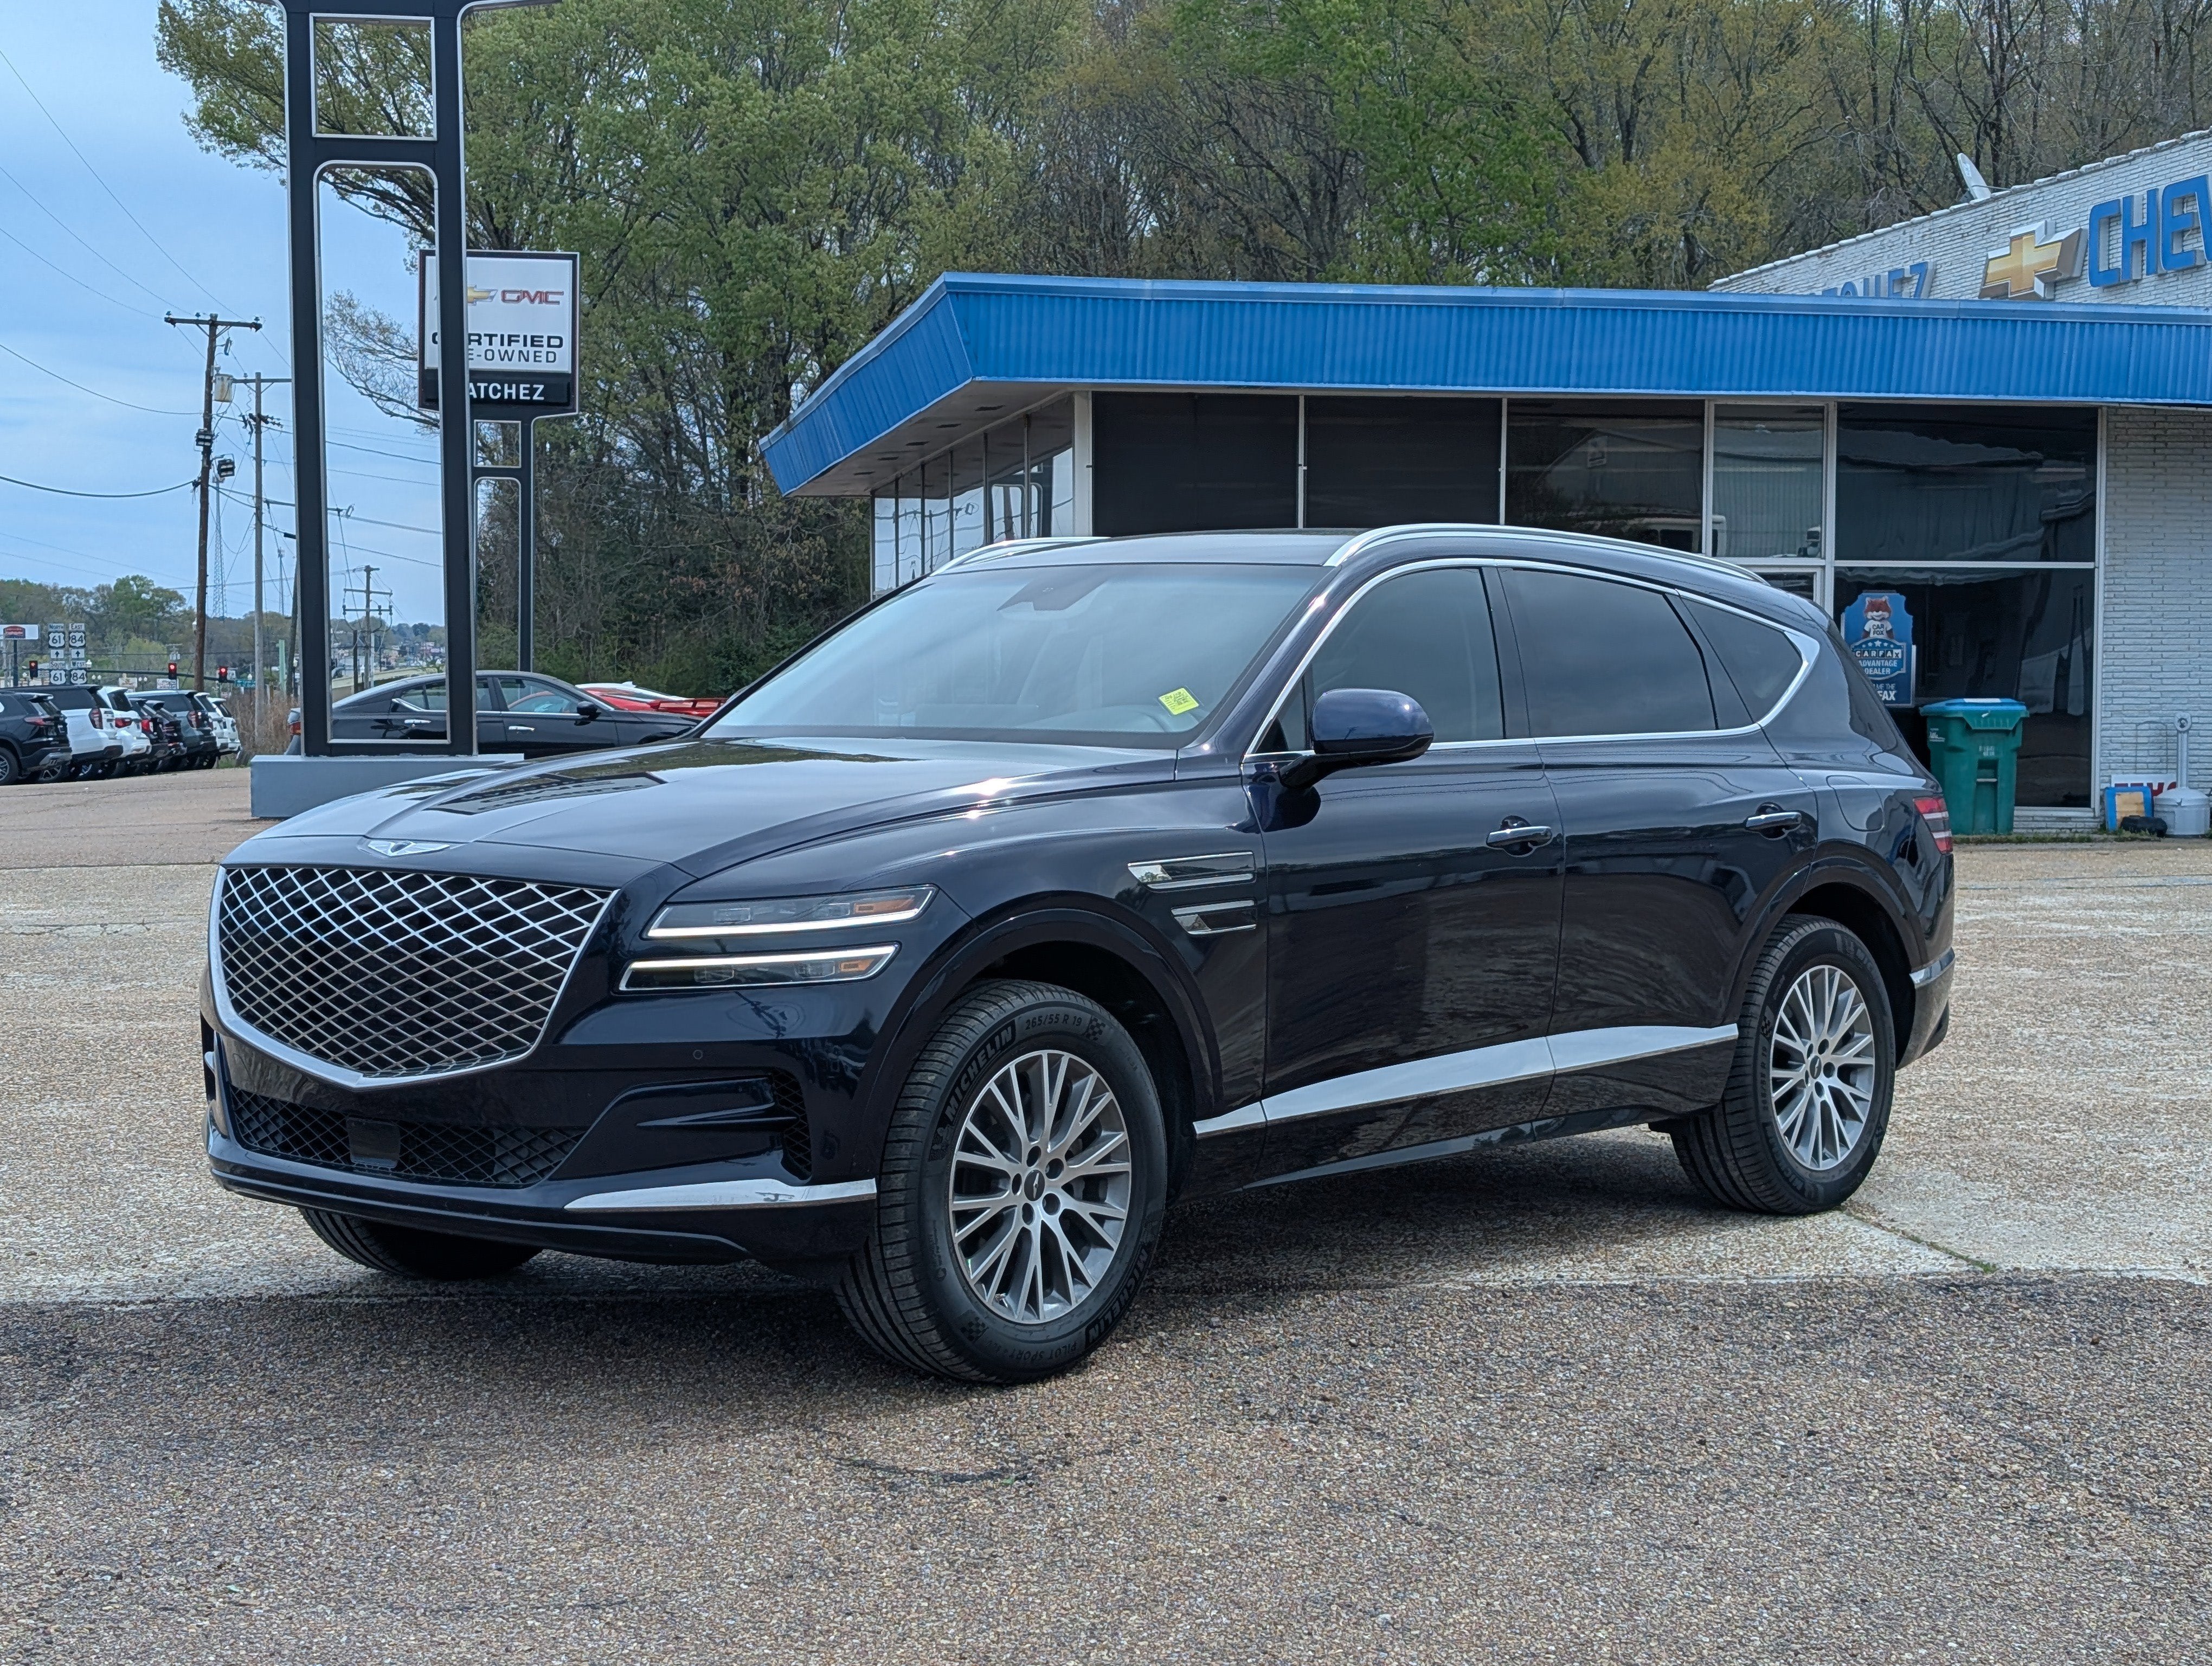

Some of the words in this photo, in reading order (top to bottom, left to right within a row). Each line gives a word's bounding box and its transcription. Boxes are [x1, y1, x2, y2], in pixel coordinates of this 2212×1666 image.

[501, 290, 564, 305] GMC
[469, 382, 544, 400] ATCHEZ
[52, 635, 61, 644] 61
[71, 635, 83, 644] 84
[1855, 649, 1901, 658] CARFAX
[53, 672, 62, 681] 61
[72, 672, 85, 681] 84
[1025, 1013, 1060, 1030] 265/55
[1062, 1014, 1069, 1024] R
[1072, 1015, 1083, 1027] 19
[944, 1026, 1013, 1122] MICHELIN
